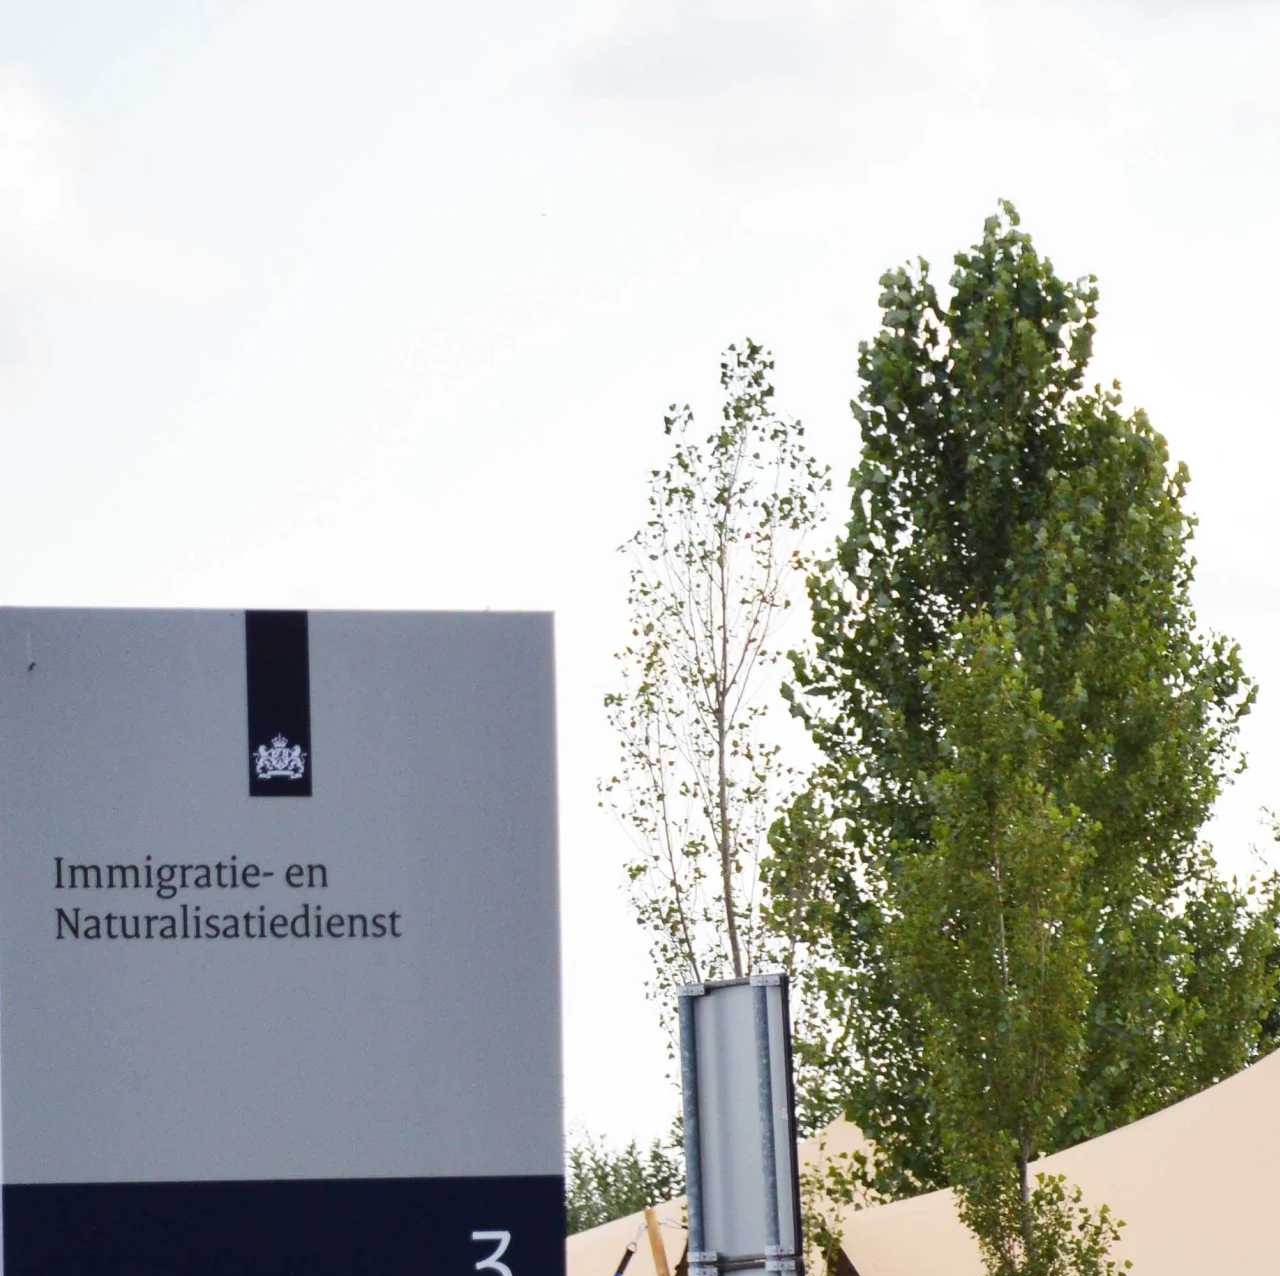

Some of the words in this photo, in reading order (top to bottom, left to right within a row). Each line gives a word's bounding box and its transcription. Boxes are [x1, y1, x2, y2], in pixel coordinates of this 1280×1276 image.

[54, 854, 274, 900] Immigratie-
[285, 863, 329, 888] en
[55, 903, 402, 940] Naturalisatiedienst
